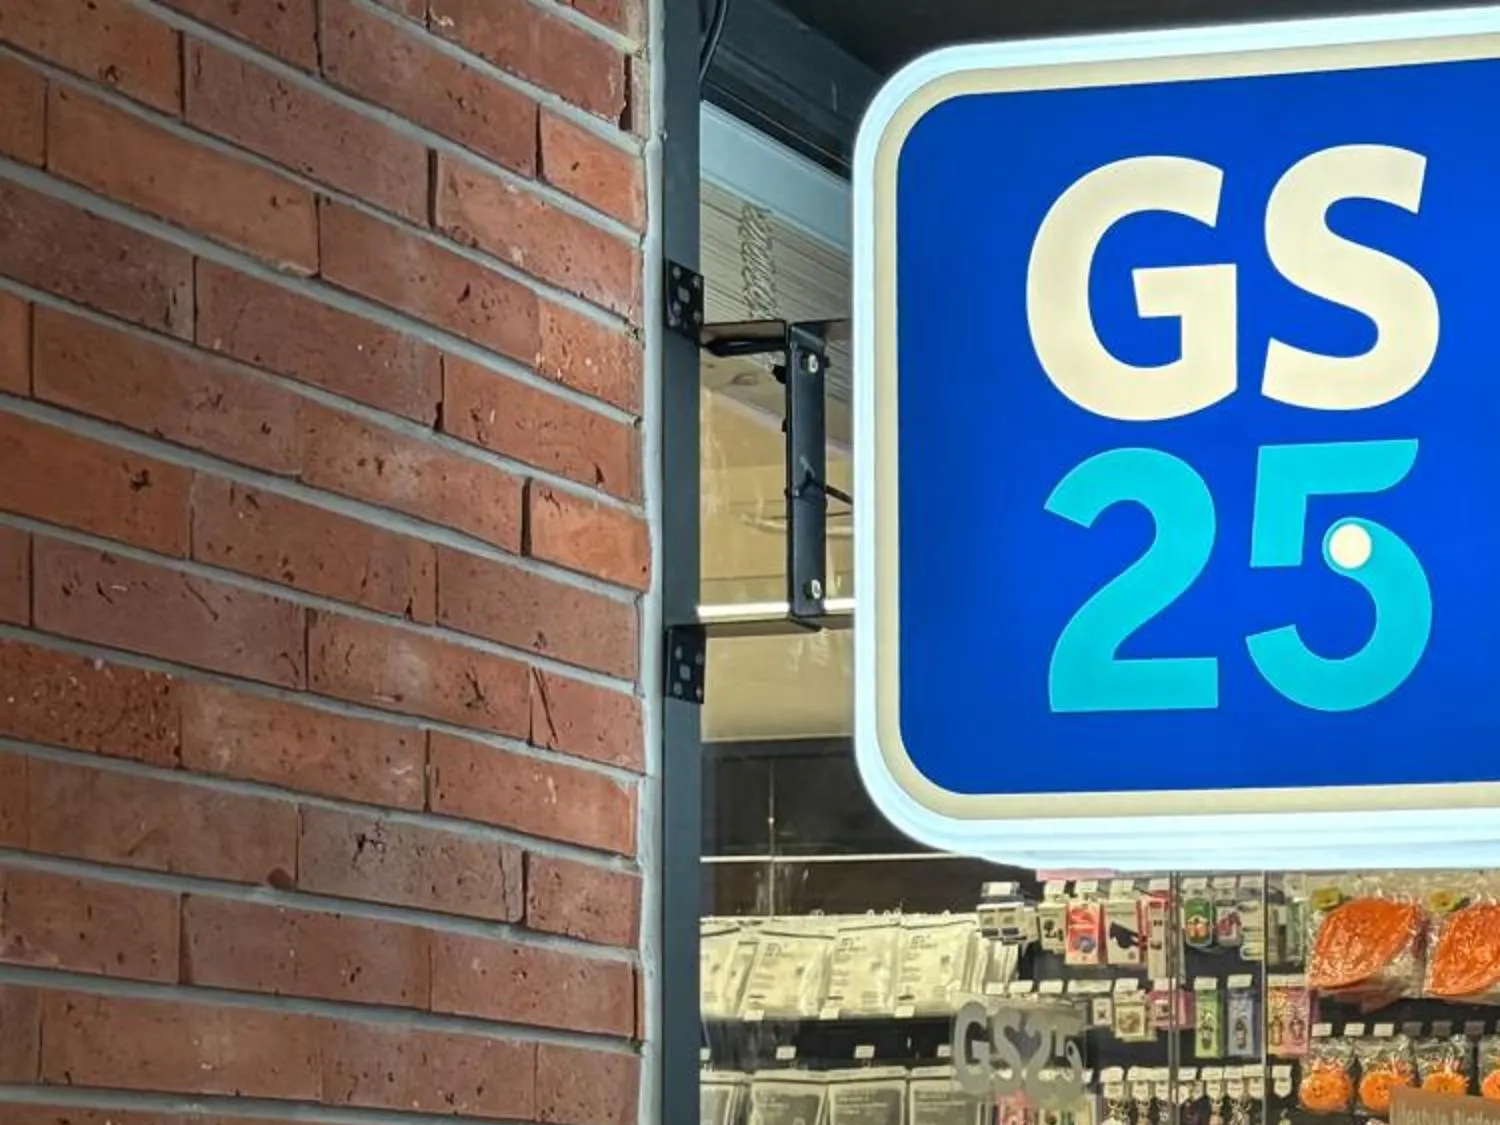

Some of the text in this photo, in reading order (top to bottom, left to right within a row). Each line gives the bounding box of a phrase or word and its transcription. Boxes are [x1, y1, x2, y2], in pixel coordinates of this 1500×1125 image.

[1025, 143, 1441, 421] GS
[1042, 439, 1433, 713] 25
[954, 1001, 1085, 1099] GS25
